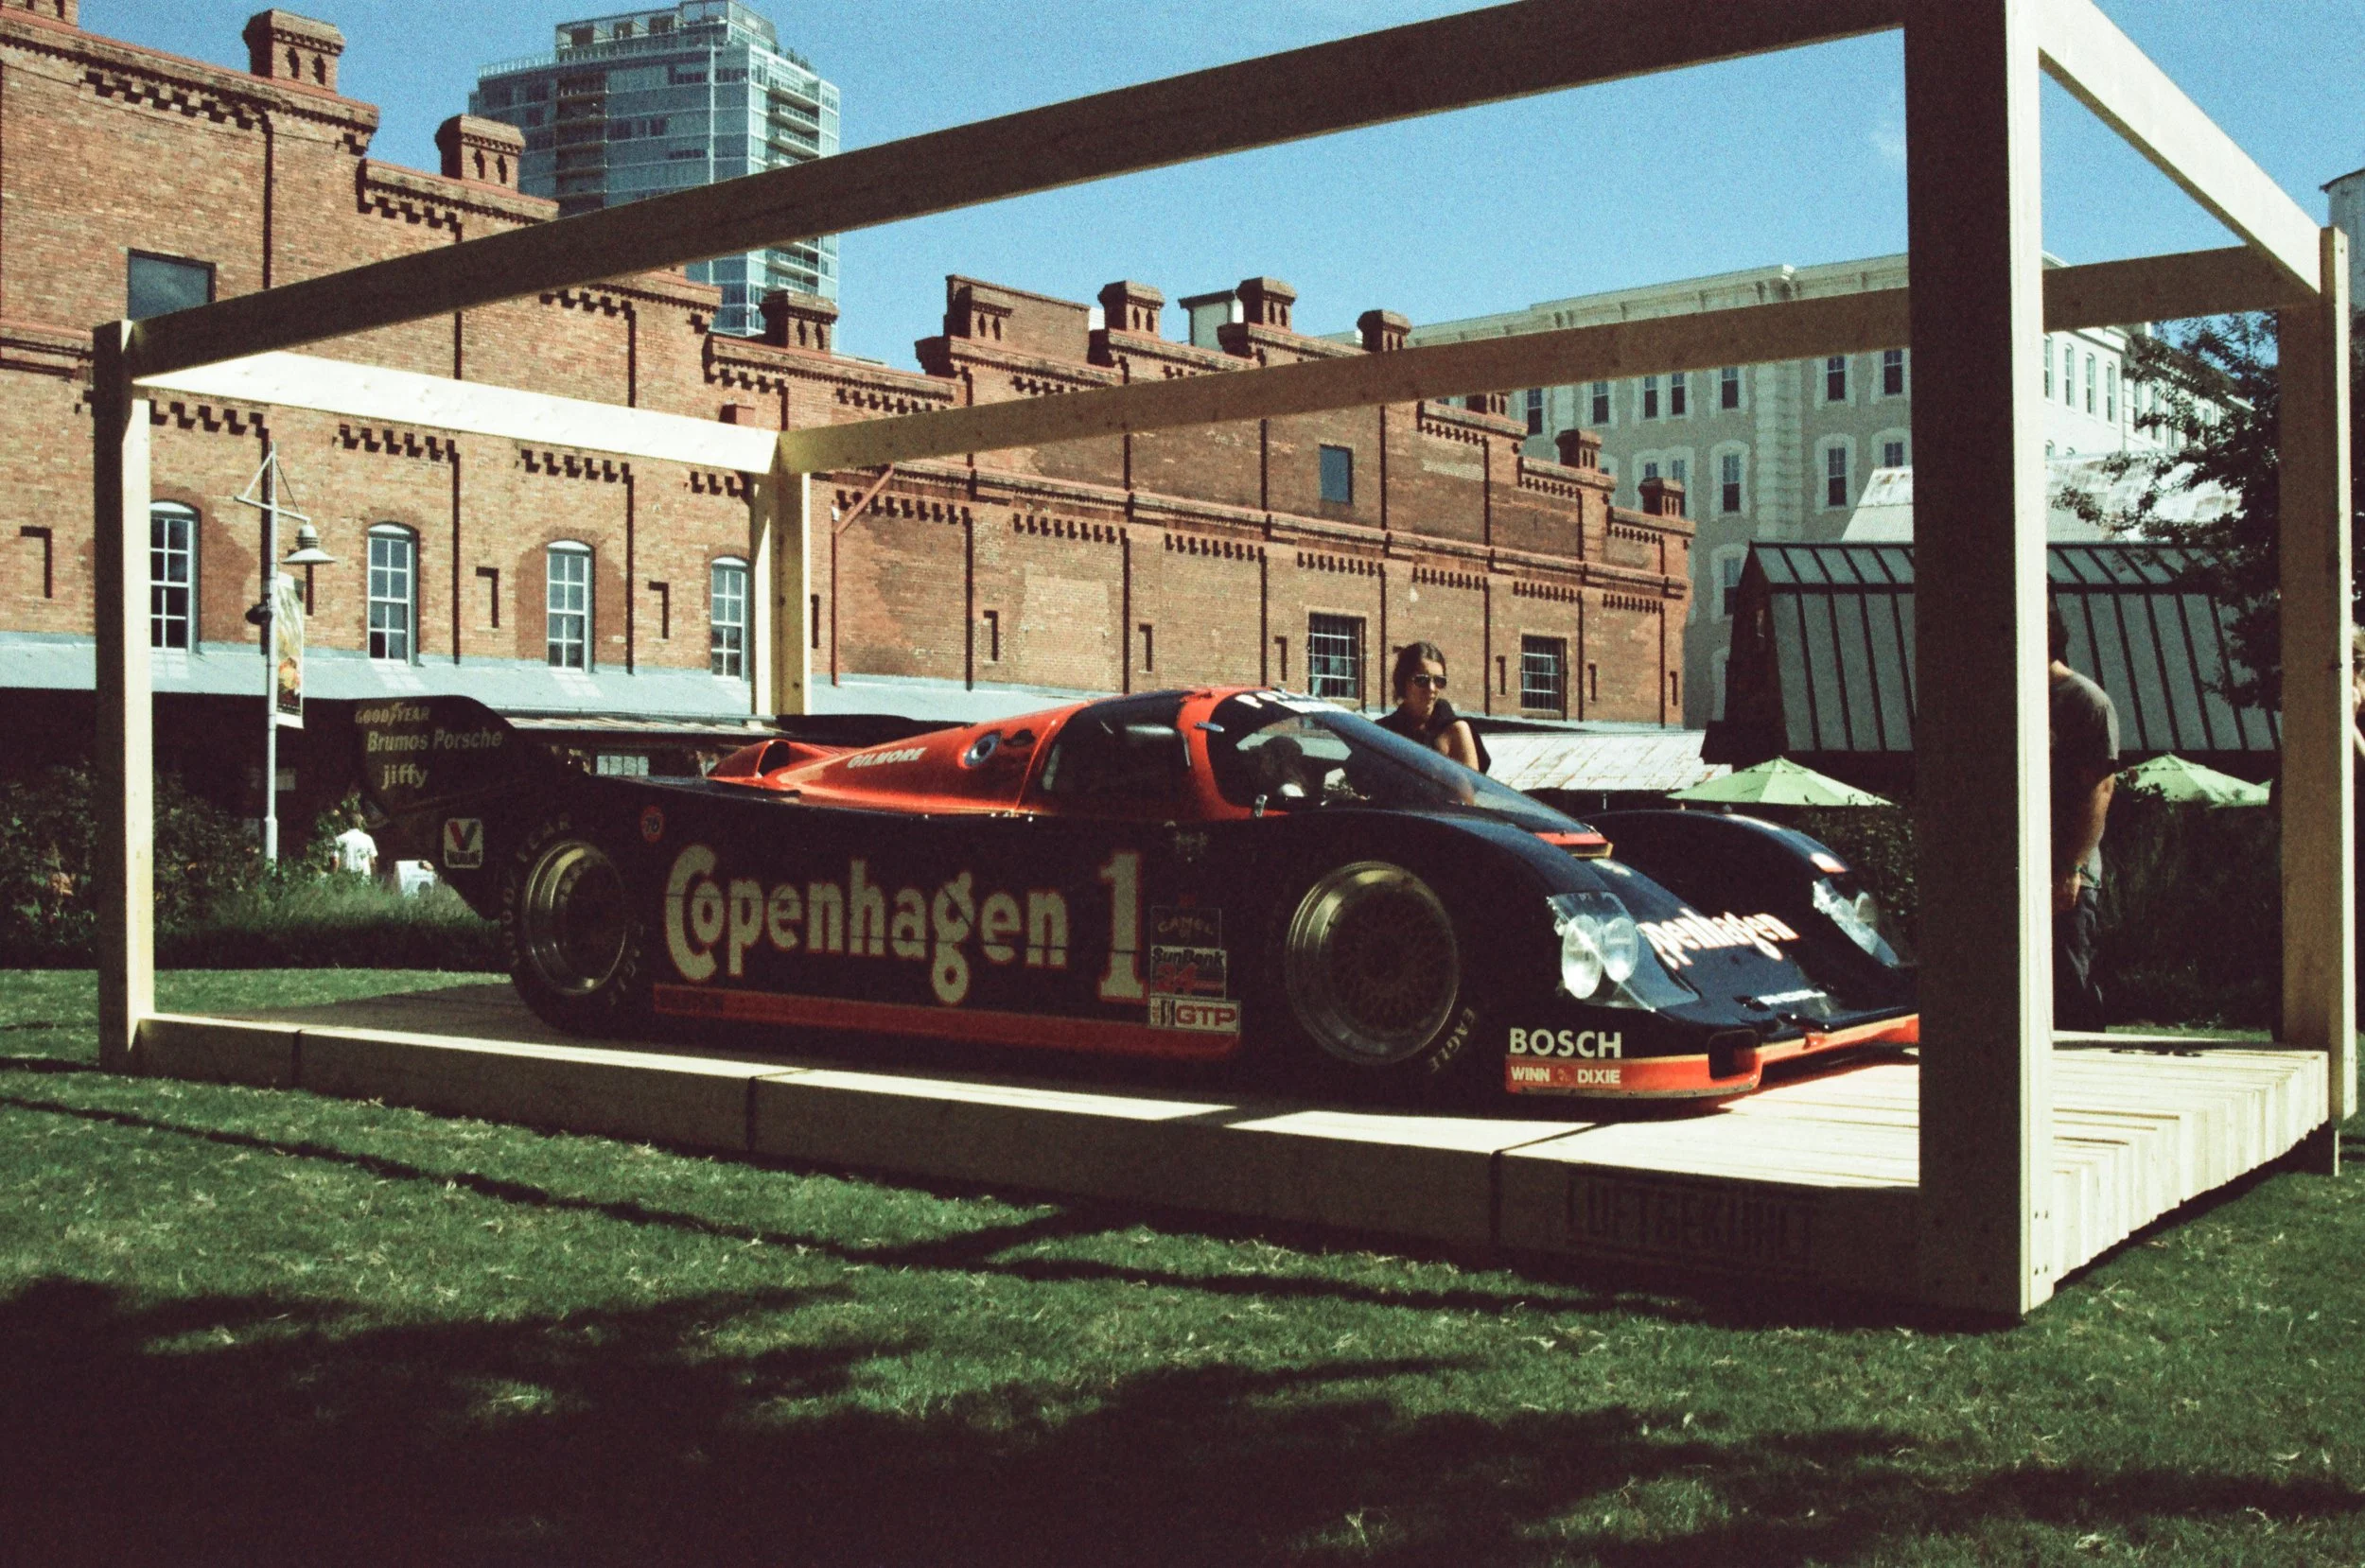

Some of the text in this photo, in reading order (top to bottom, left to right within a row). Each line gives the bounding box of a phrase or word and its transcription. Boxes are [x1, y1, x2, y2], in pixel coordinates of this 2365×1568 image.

[354, 703, 429, 725] GOODYEAR
[367, 726, 502, 753] Brumos Porsche
[847, 747, 927, 769] GILMORE
[381, 763, 428, 791] jiffy
[665, 845, 1067, 1004] Copenhagen
[1098, 853, 1144, 1001] 1
[1152, 948, 1223, 967] SunBank
[1176, 1005, 1236, 1027] GTP
[1426, 1007, 1478, 1073] EAGLE
[1510, 1027, 1621, 1058] BOSCH
[1511, 1066, 1620, 1084] WINN DIXIE
